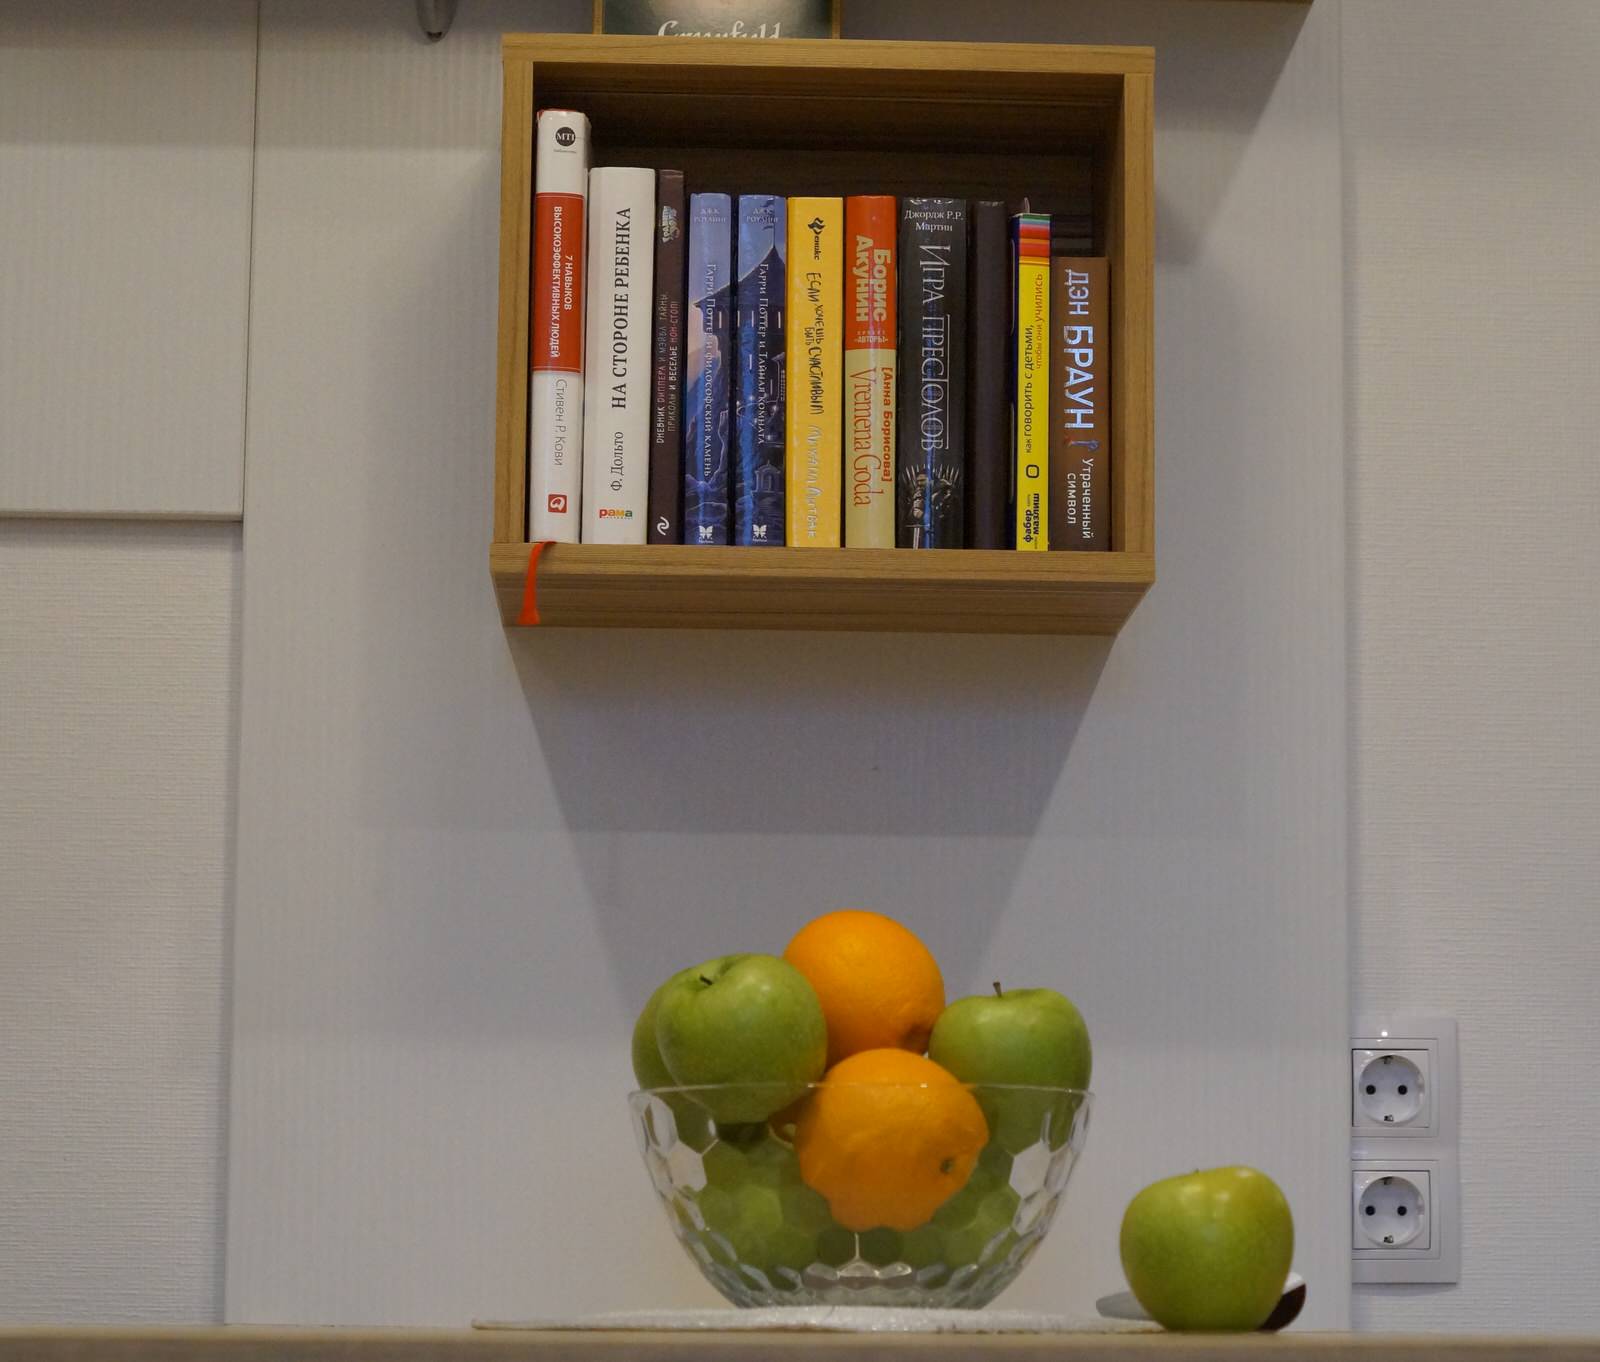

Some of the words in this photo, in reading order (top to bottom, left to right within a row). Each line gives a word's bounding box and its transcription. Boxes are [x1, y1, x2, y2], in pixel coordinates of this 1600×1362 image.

[904, 210, 944, 220] Джордж
[916, 222, 953, 232] Мартин
[551, 206, 562, 320] ВЫСОКОЭФФЕКТИВНЫХ
[614, 208, 630, 289] РЕБЕНКА
[564, 262, 573, 310] НАВЫКОВ
[852, 235, 874, 322] Акунин
[870, 249, 891, 322] Борис
[919, 245, 951, 304] ИГРА
[1034, 273, 1045, 322] учились
[1064, 269, 1089, 315] ДЭН
[550, 322, 560, 358] ЛЮДЕЙ
[612, 293, 629, 377] СТОРОНЕ
[1023, 324, 1034, 371] детьми,
[1034, 343, 1043, 369] чтобы
[668, 345, 677, 381] ВЕСЕЛЬЕ
[881, 367, 893, 406] [Анна
[921, 315, 950, 451] ПРЕСТОЛОВ
[1064, 326, 1094, 429] БРАУН
[554, 378, 567, 421] Стивен
[611, 383, 627, 409] НА
[849, 367, 877, 451] Vremena
[1023, 383, 1034, 437] говорить
[554, 436, 565, 467] Кови
[555, 425, 566, 433] Р.
[881, 411, 893, 482] Борисова]
[611, 431, 624, 476] Дольто
[610, 478, 623, 492] Ф.
[853, 454, 884, 507] Goda
[1067, 472, 1077, 524] символ
[1080, 458, 1094, 539] Утраченный
[1023, 509, 1033, 543] фабер
[1032, 493, 1040, 535] мазлиш
